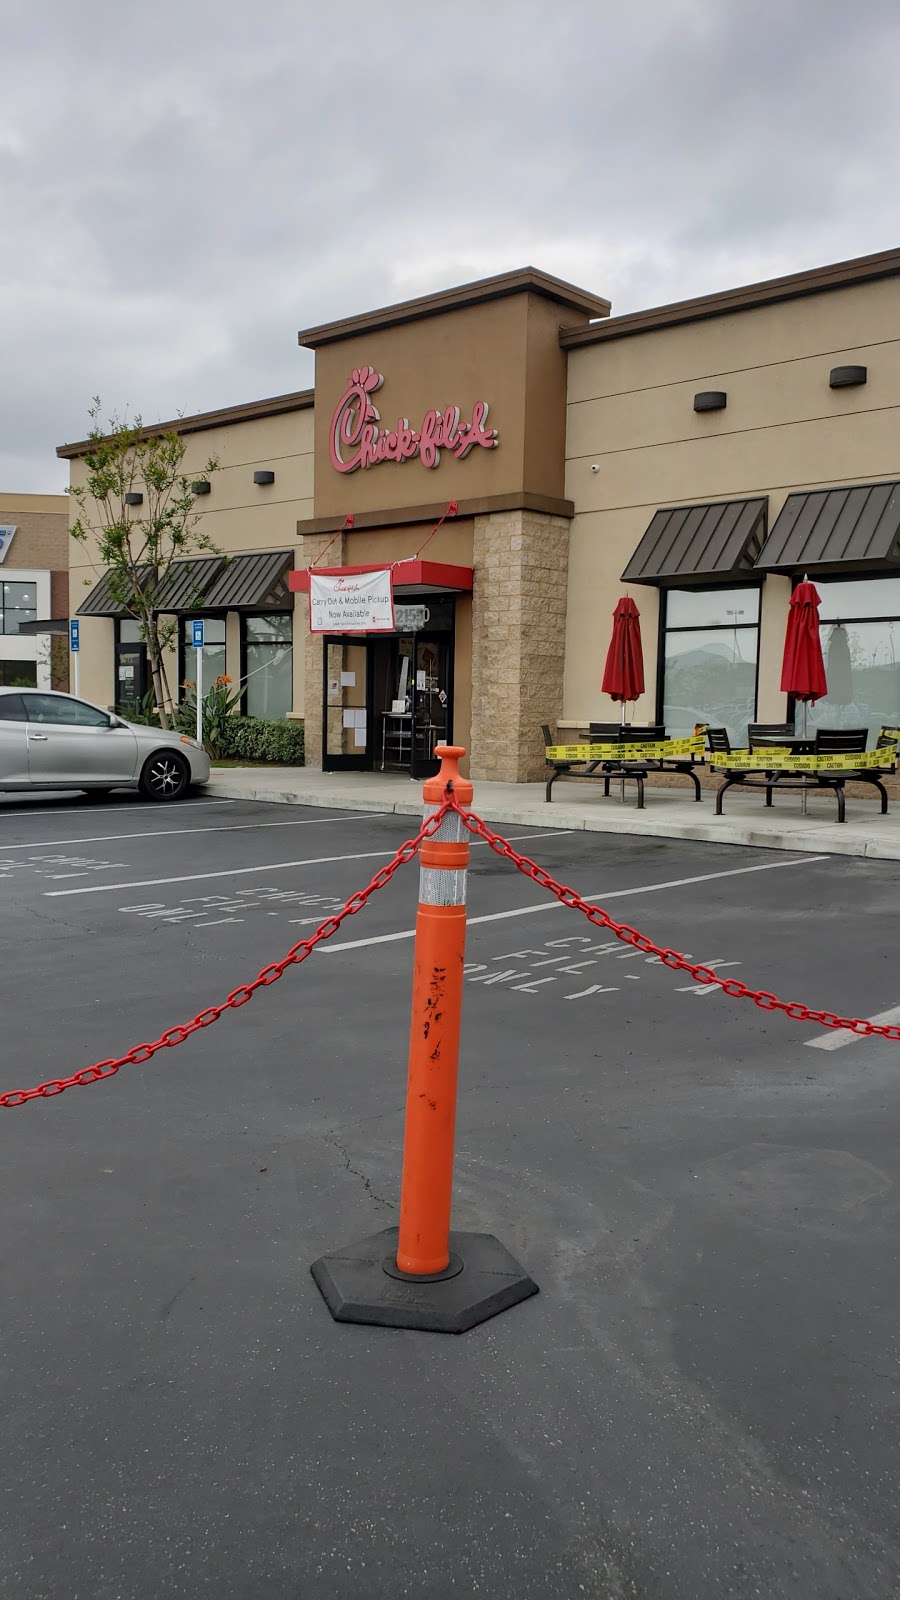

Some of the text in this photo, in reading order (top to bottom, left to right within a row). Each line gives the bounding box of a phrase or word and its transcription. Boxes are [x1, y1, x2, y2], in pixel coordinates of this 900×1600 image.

[329, 365, 499, 474] Chick-fil-A
[312, 595, 389, 607] Carry Out & Mobile Pickup
[328, 609, 370, 618] Now Available
[236, 887, 371, 911] CHICK
[118, 903, 245, 927] ONLY
[543, 936, 743, 973] CHICK
